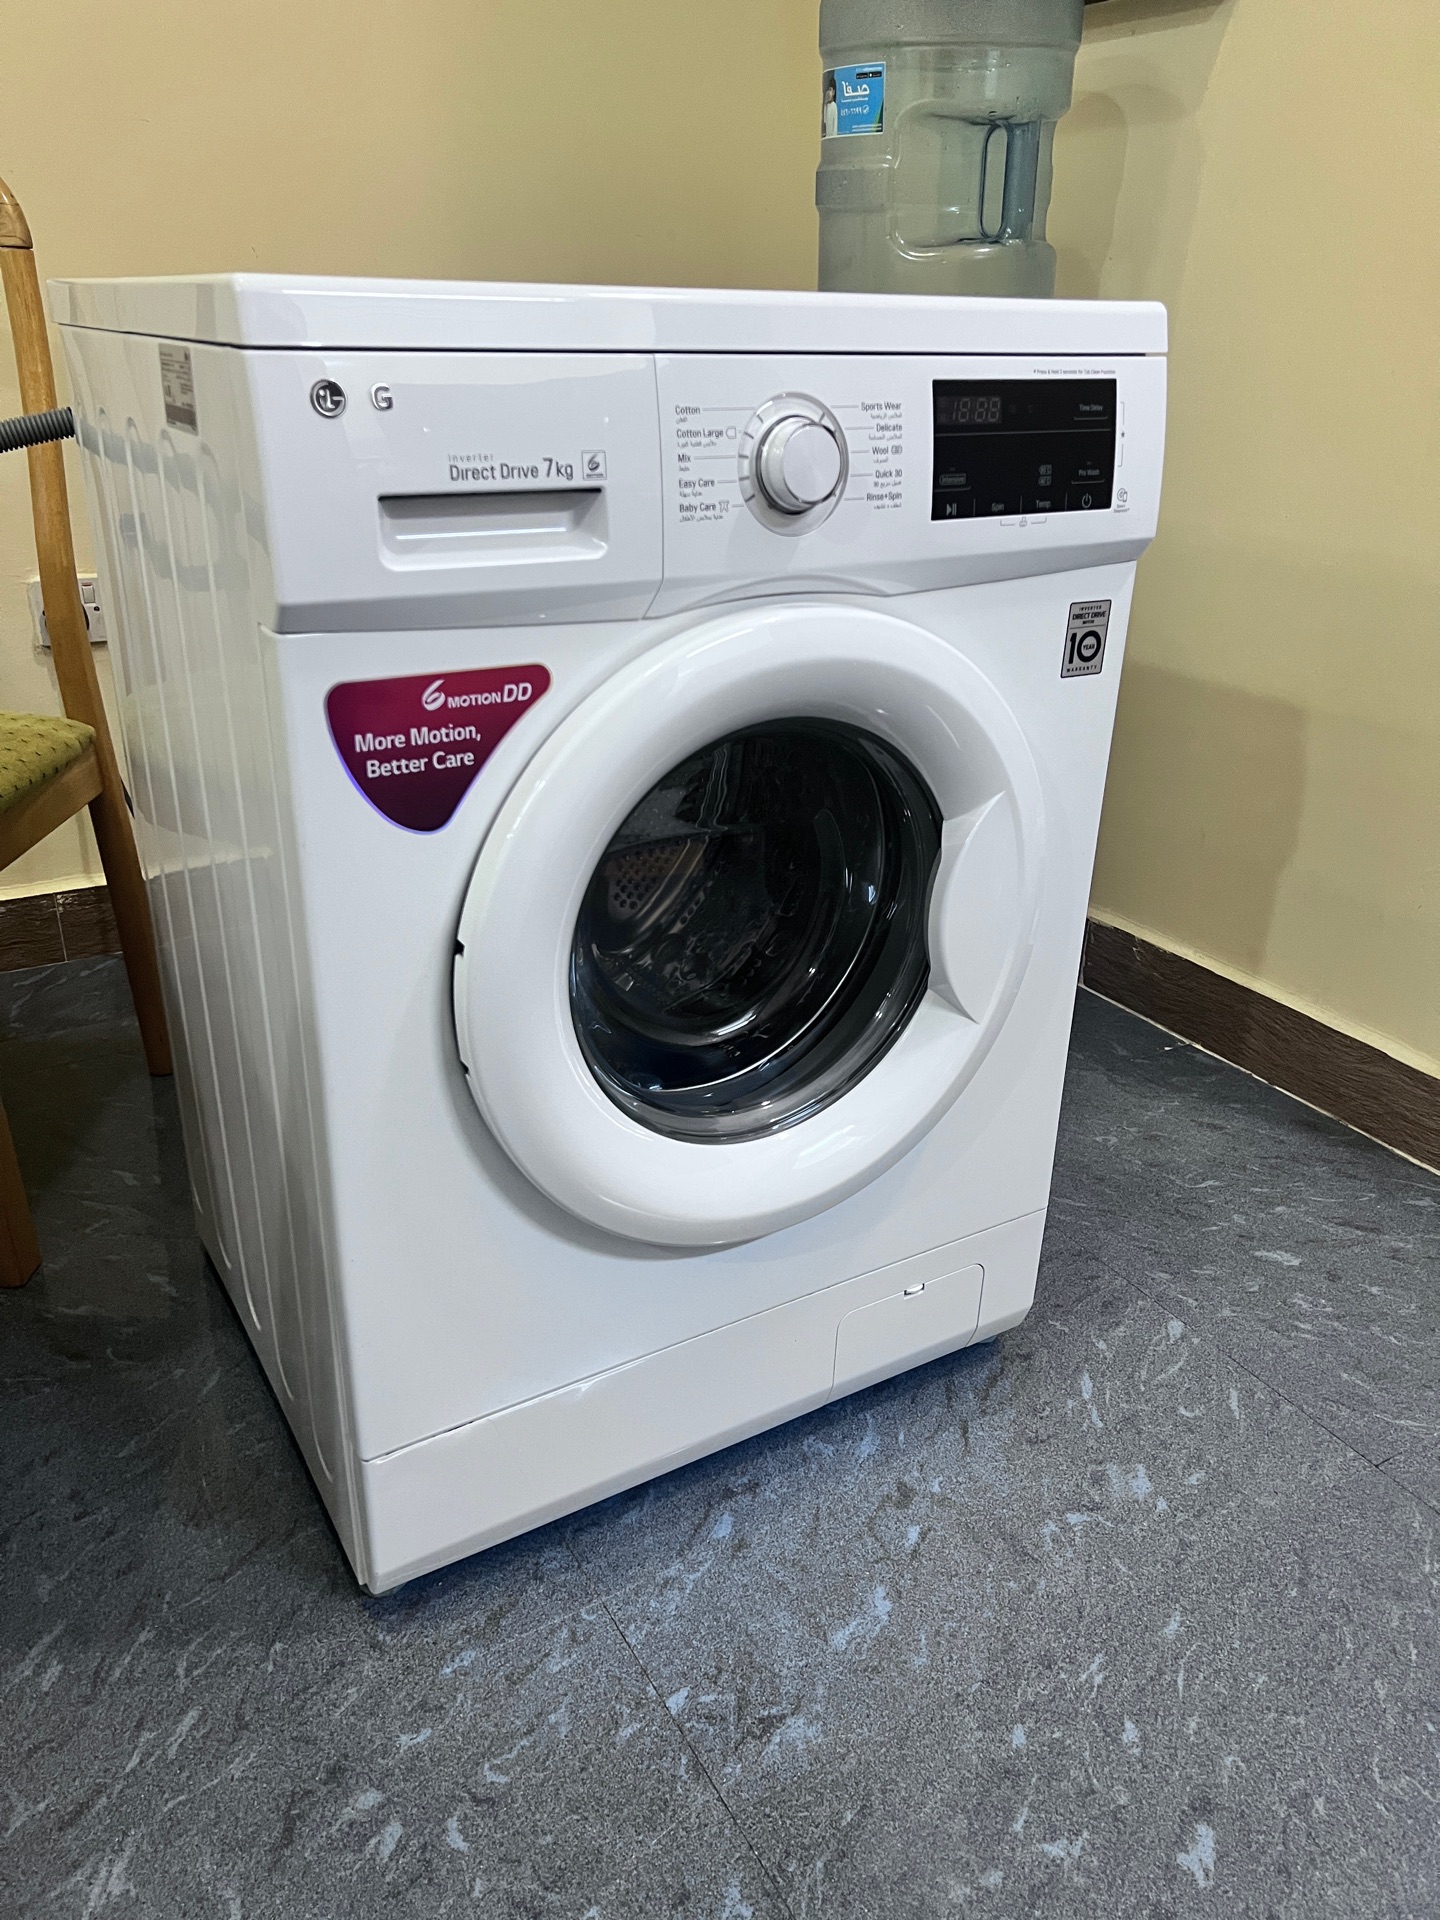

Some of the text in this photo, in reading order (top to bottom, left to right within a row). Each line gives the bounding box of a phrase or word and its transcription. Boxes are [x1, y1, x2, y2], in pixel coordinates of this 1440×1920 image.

[841, 80, 870, 97] صفا
[675, 405, 701, 415] Cotton
[861, 401, 901, 412] Sports Wear
[676, 428, 724, 440] Cotton Large
[876, 423, 902, 433] Delicate
[871, 446, 889, 455] Wool
[678, 454, 691, 463] Mix
[449, 464, 497, 481] Direct
[500, 463, 539, 480] Drive
[875, 468, 902, 479] Quick 30
[679, 478, 715, 490] Easy Care
[866, 491, 903, 501] Rinse+Spin
[679, 502, 717, 514] Baby Care
[991, 500, 1051, 512] Spin Temp
[1072, 610, 1106, 620] DIRECT DRIVE
[1068, 630, 1101, 664] 10
[1067, 664, 1097, 673] WARRANTY
[447, 691, 502, 709] MOTION
[502, 682, 533, 703] DD
[353, 724, 481, 753] More Motion,
[366, 751, 475, 779] Better Care
